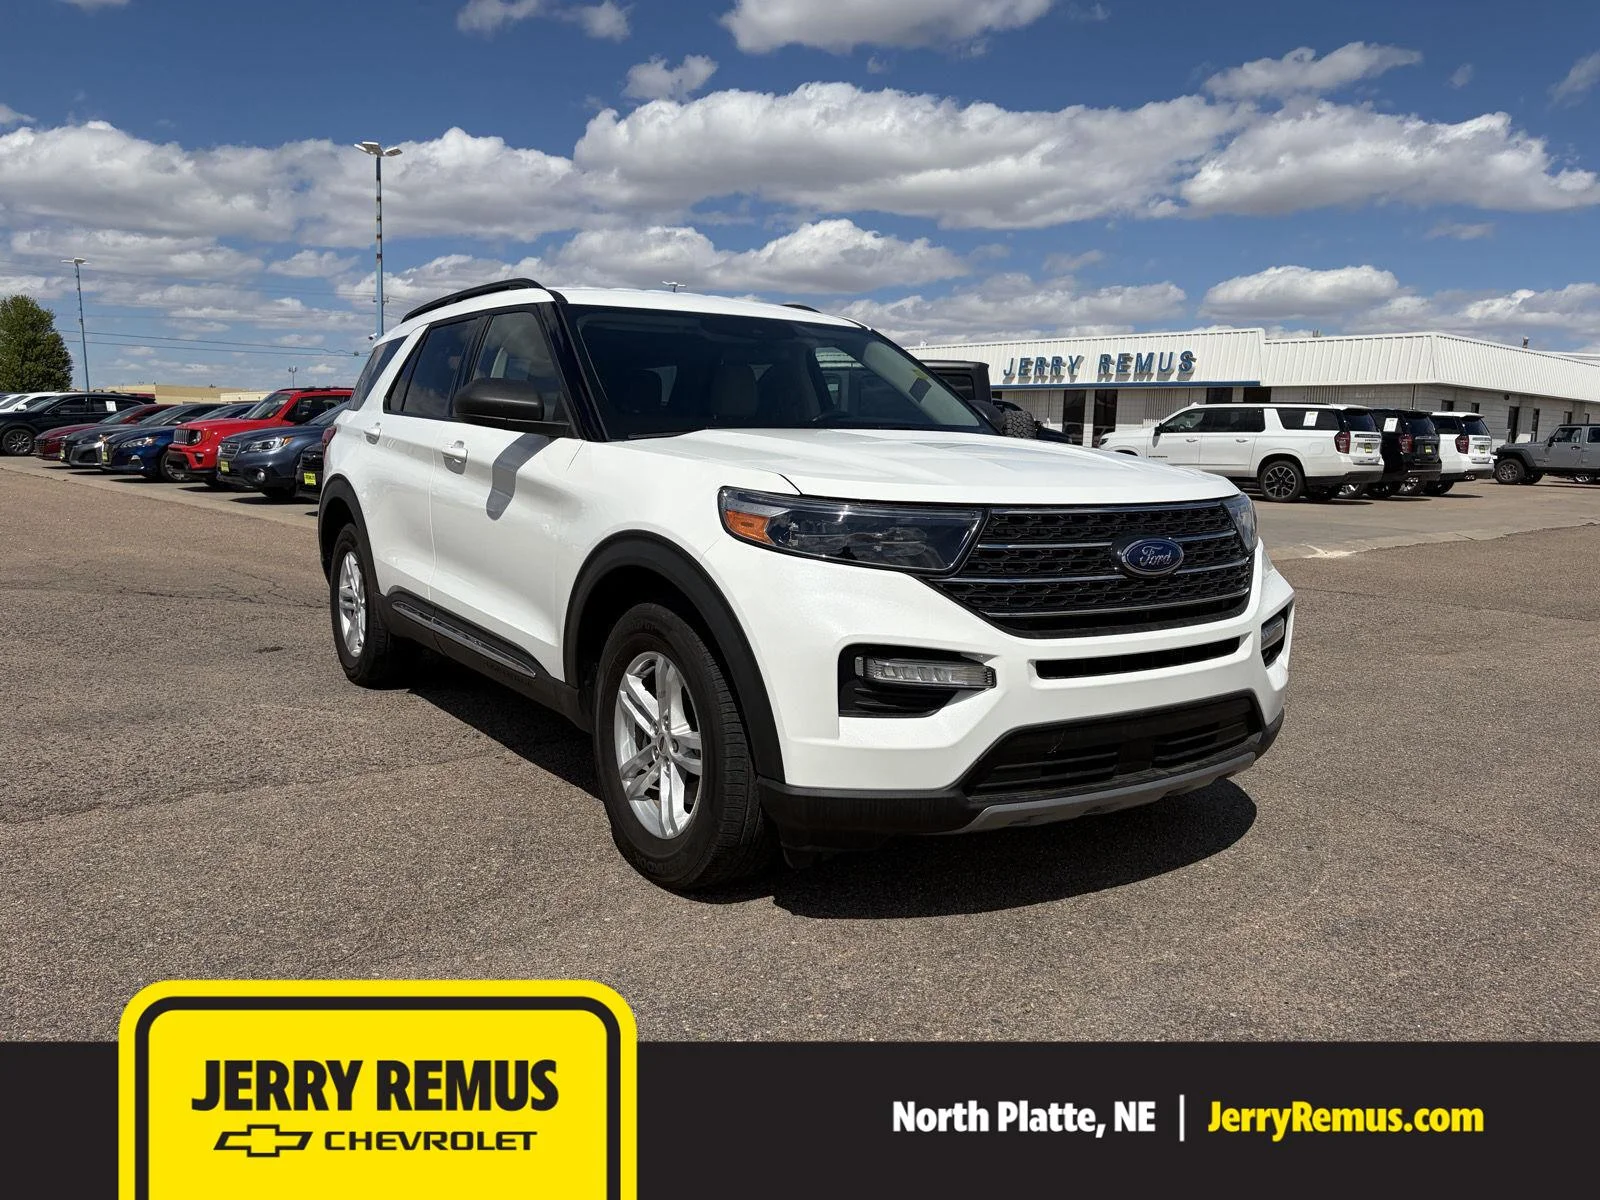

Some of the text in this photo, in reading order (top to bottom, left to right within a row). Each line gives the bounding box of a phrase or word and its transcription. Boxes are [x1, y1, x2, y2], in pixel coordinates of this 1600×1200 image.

[1003, 351, 1196, 378] JERRY REMUS
[1140, 545, 1172, 567] Ford
